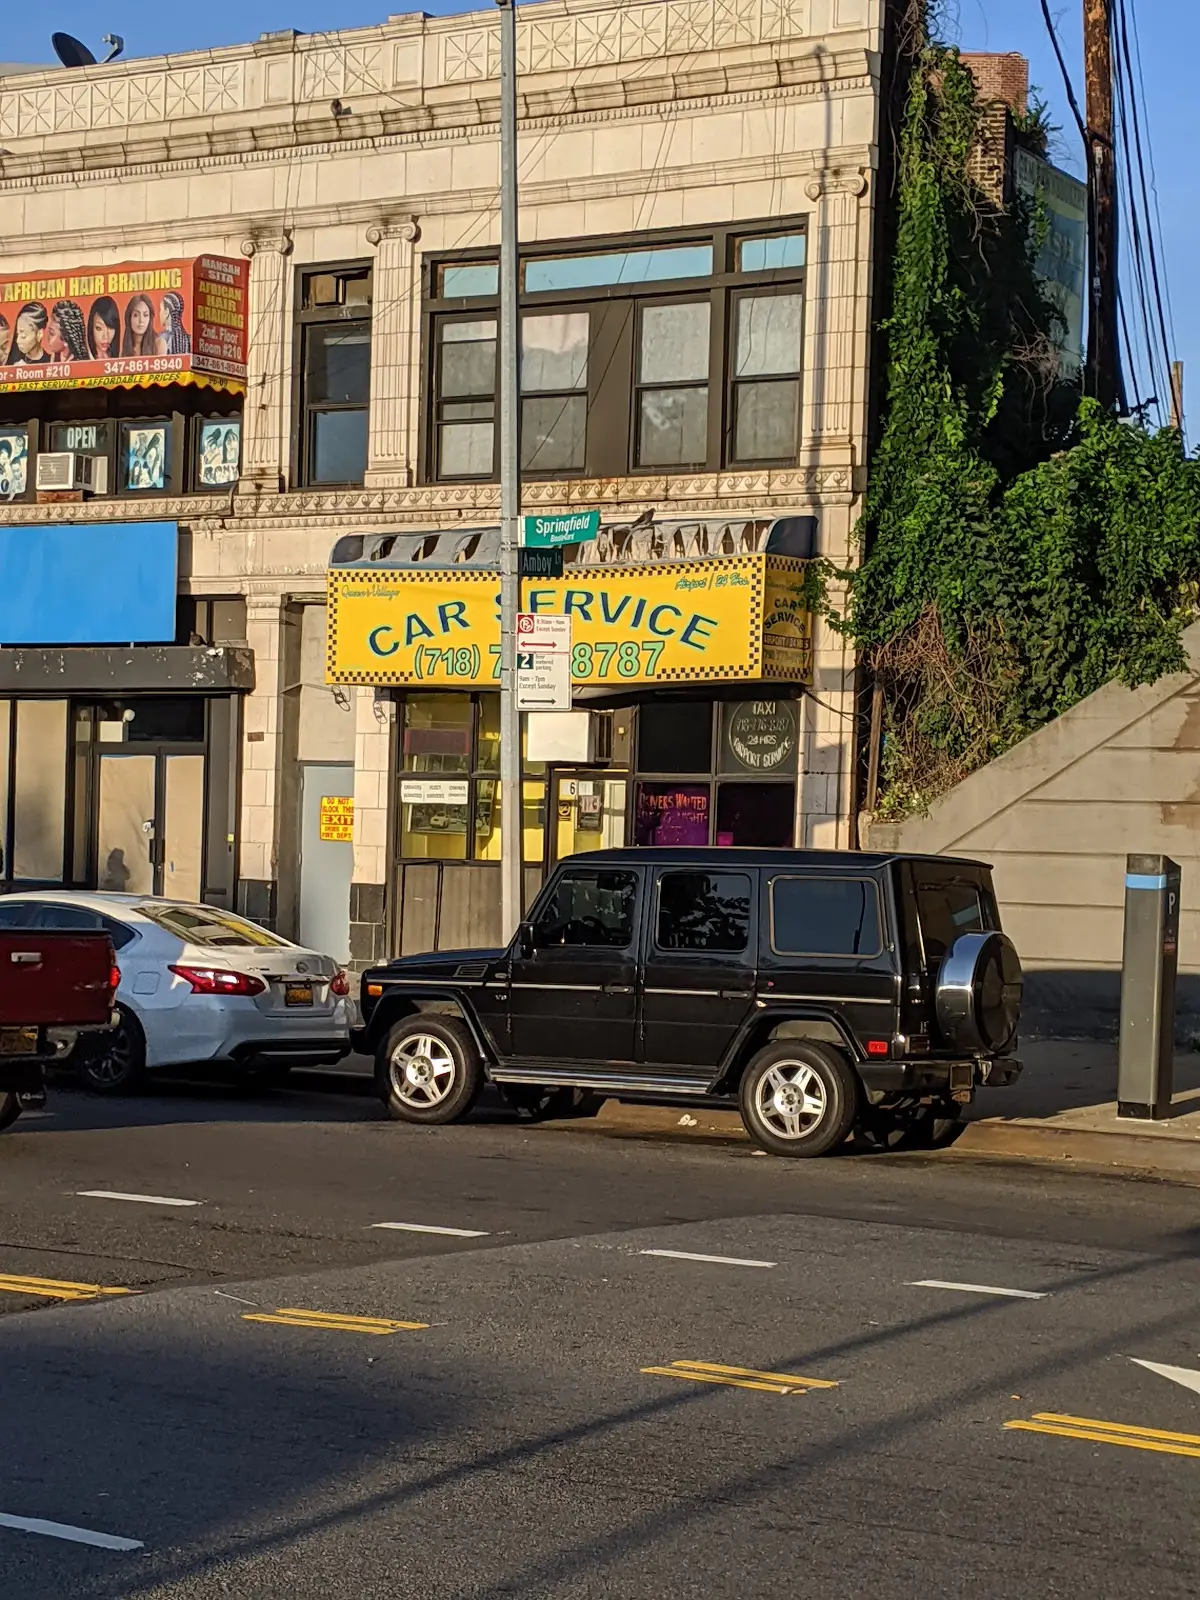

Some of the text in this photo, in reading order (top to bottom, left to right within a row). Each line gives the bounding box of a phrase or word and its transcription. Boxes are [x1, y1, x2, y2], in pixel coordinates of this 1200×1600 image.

[4, 267, 182, 302] AFRICAN HAIR BRAIDING
[208, 269, 233, 283] SITA
[199, 280, 242, 302] AFRICAN
[206, 295, 236, 312] HAIR
[197, 305, 244, 329] BRAIDING
[199, 338, 242, 360] Room #210
[16, 368, 43, 380] Room
[46, 364, 71, 378] #210
[104, 358, 182, 374] 347-861-8940
[197, 356, 244, 375] 347-861-8940
[17, 382, 39, 391] FAST
[42, 380, 78, 389] SERVICE
[87, 373, 180, 387] AFFORDABLE PRICES
[67, 426, 97, 449] OPEN
[535, 514, 591, 537] Springfield
[523, 551, 552, 576] Amboy
[774, 598, 798, 611] CAR
[368, 601, 472, 657] CAR
[764, 611, 806, 632] SERVICE
[414, 644, 480, 679] (718)
[521, 654, 530, 668] 2
[538, 683, 556, 691] Sunday
[753, 701, 776, 715] TAXI
[747, 734, 777, 745] 24 HRS
[322, 815, 354, 825] EXIT
[1168, 892, 1176, 914] P
